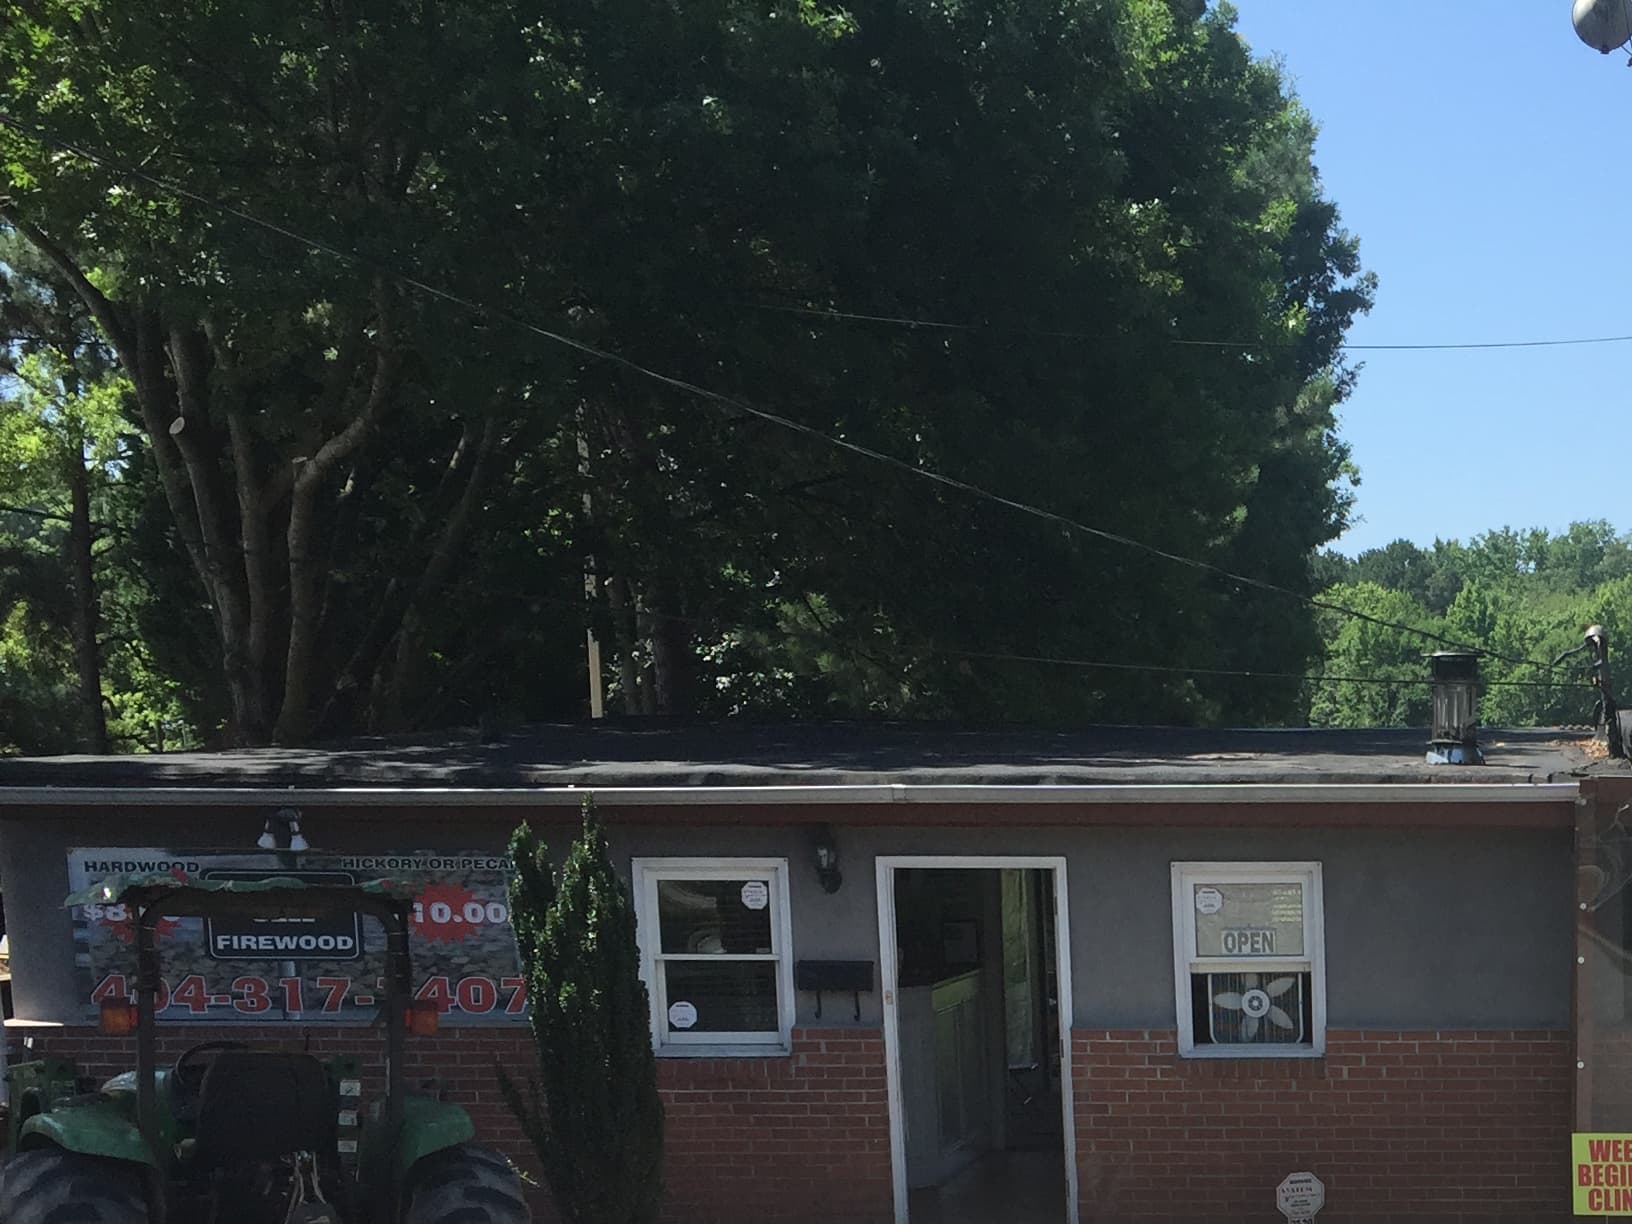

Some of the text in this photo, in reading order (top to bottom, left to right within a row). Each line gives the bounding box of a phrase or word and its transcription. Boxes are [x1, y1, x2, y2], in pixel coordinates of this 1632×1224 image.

[83, 860, 200, 873] HARDWOOD
[342, 858, 423, 870] HICKORY
[428, 858, 455, 870] OR
[393, 902, 508, 923] 10.00
[216, 935, 354, 950] FIREWOOD
[1223, 932, 1274, 954] OPEN
[91, 974, 528, 1015] 404-317-407
